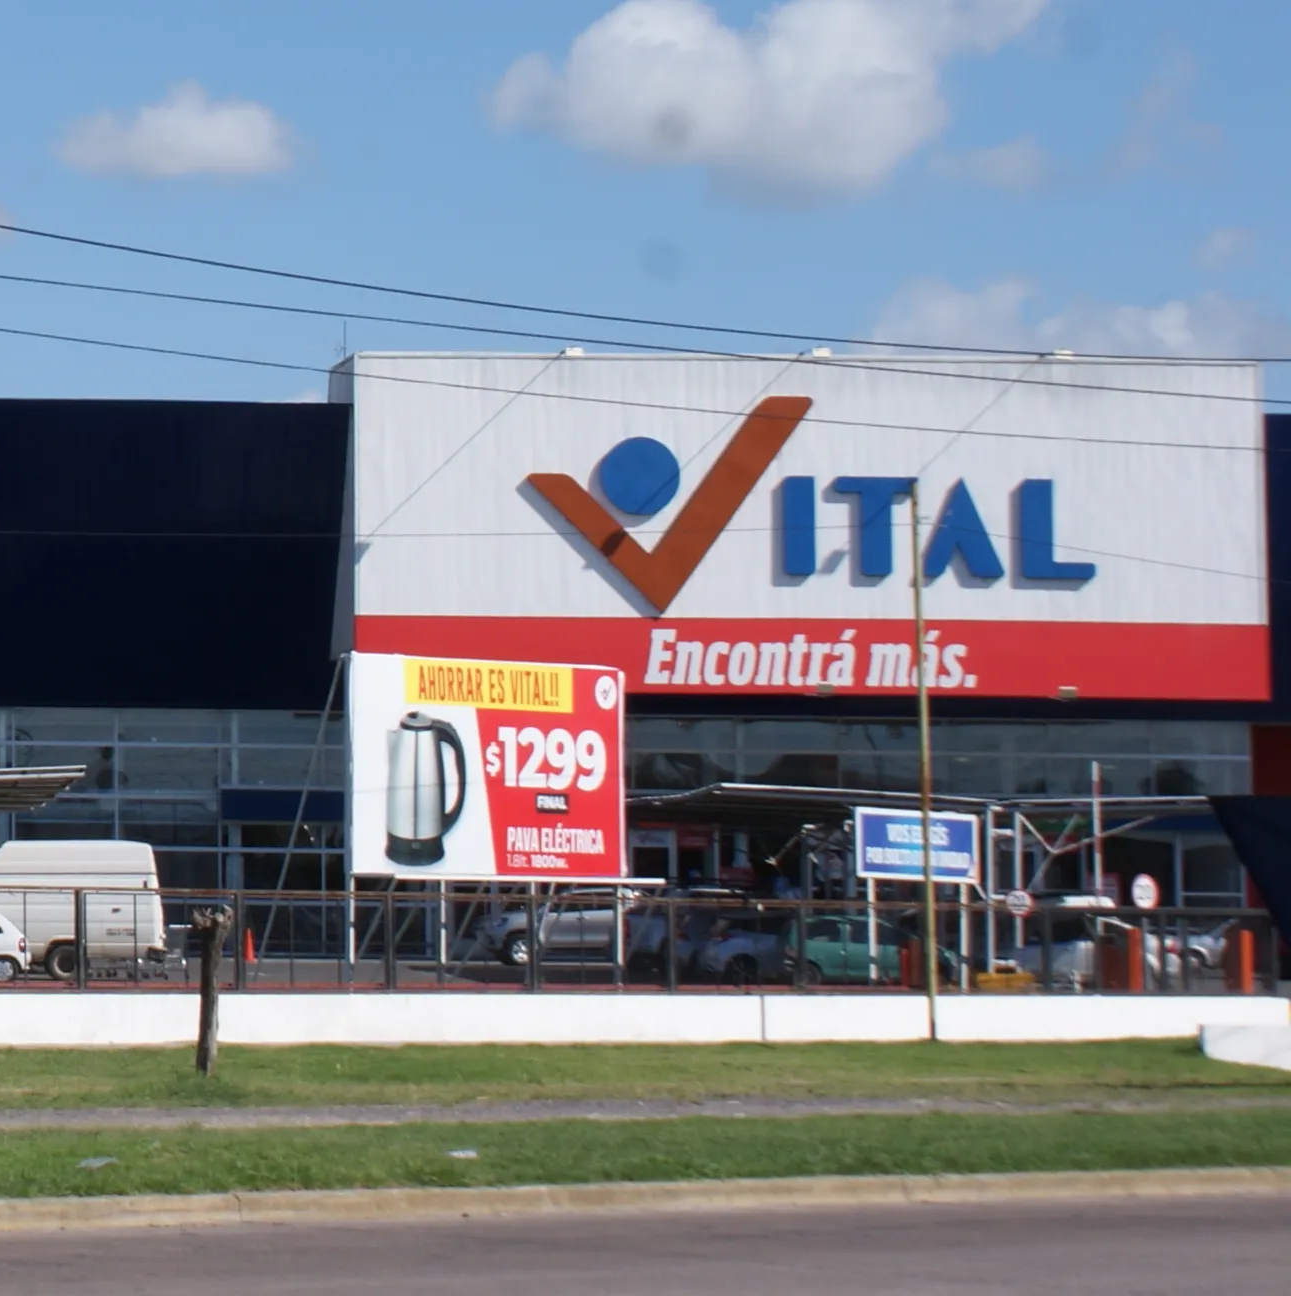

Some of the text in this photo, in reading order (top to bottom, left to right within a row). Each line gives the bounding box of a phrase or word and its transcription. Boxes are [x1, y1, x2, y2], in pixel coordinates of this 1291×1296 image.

[644, 629, 978, 689] Encontrá más.
[418, 665, 560, 707] AHORRAR ES VITAL!!
[485, 726, 607, 792] $1299
[536, 795, 567, 810] FINAL
[506, 826, 540, 853] PAVA
[541, 822, 605, 855] ELÉCTRICA
